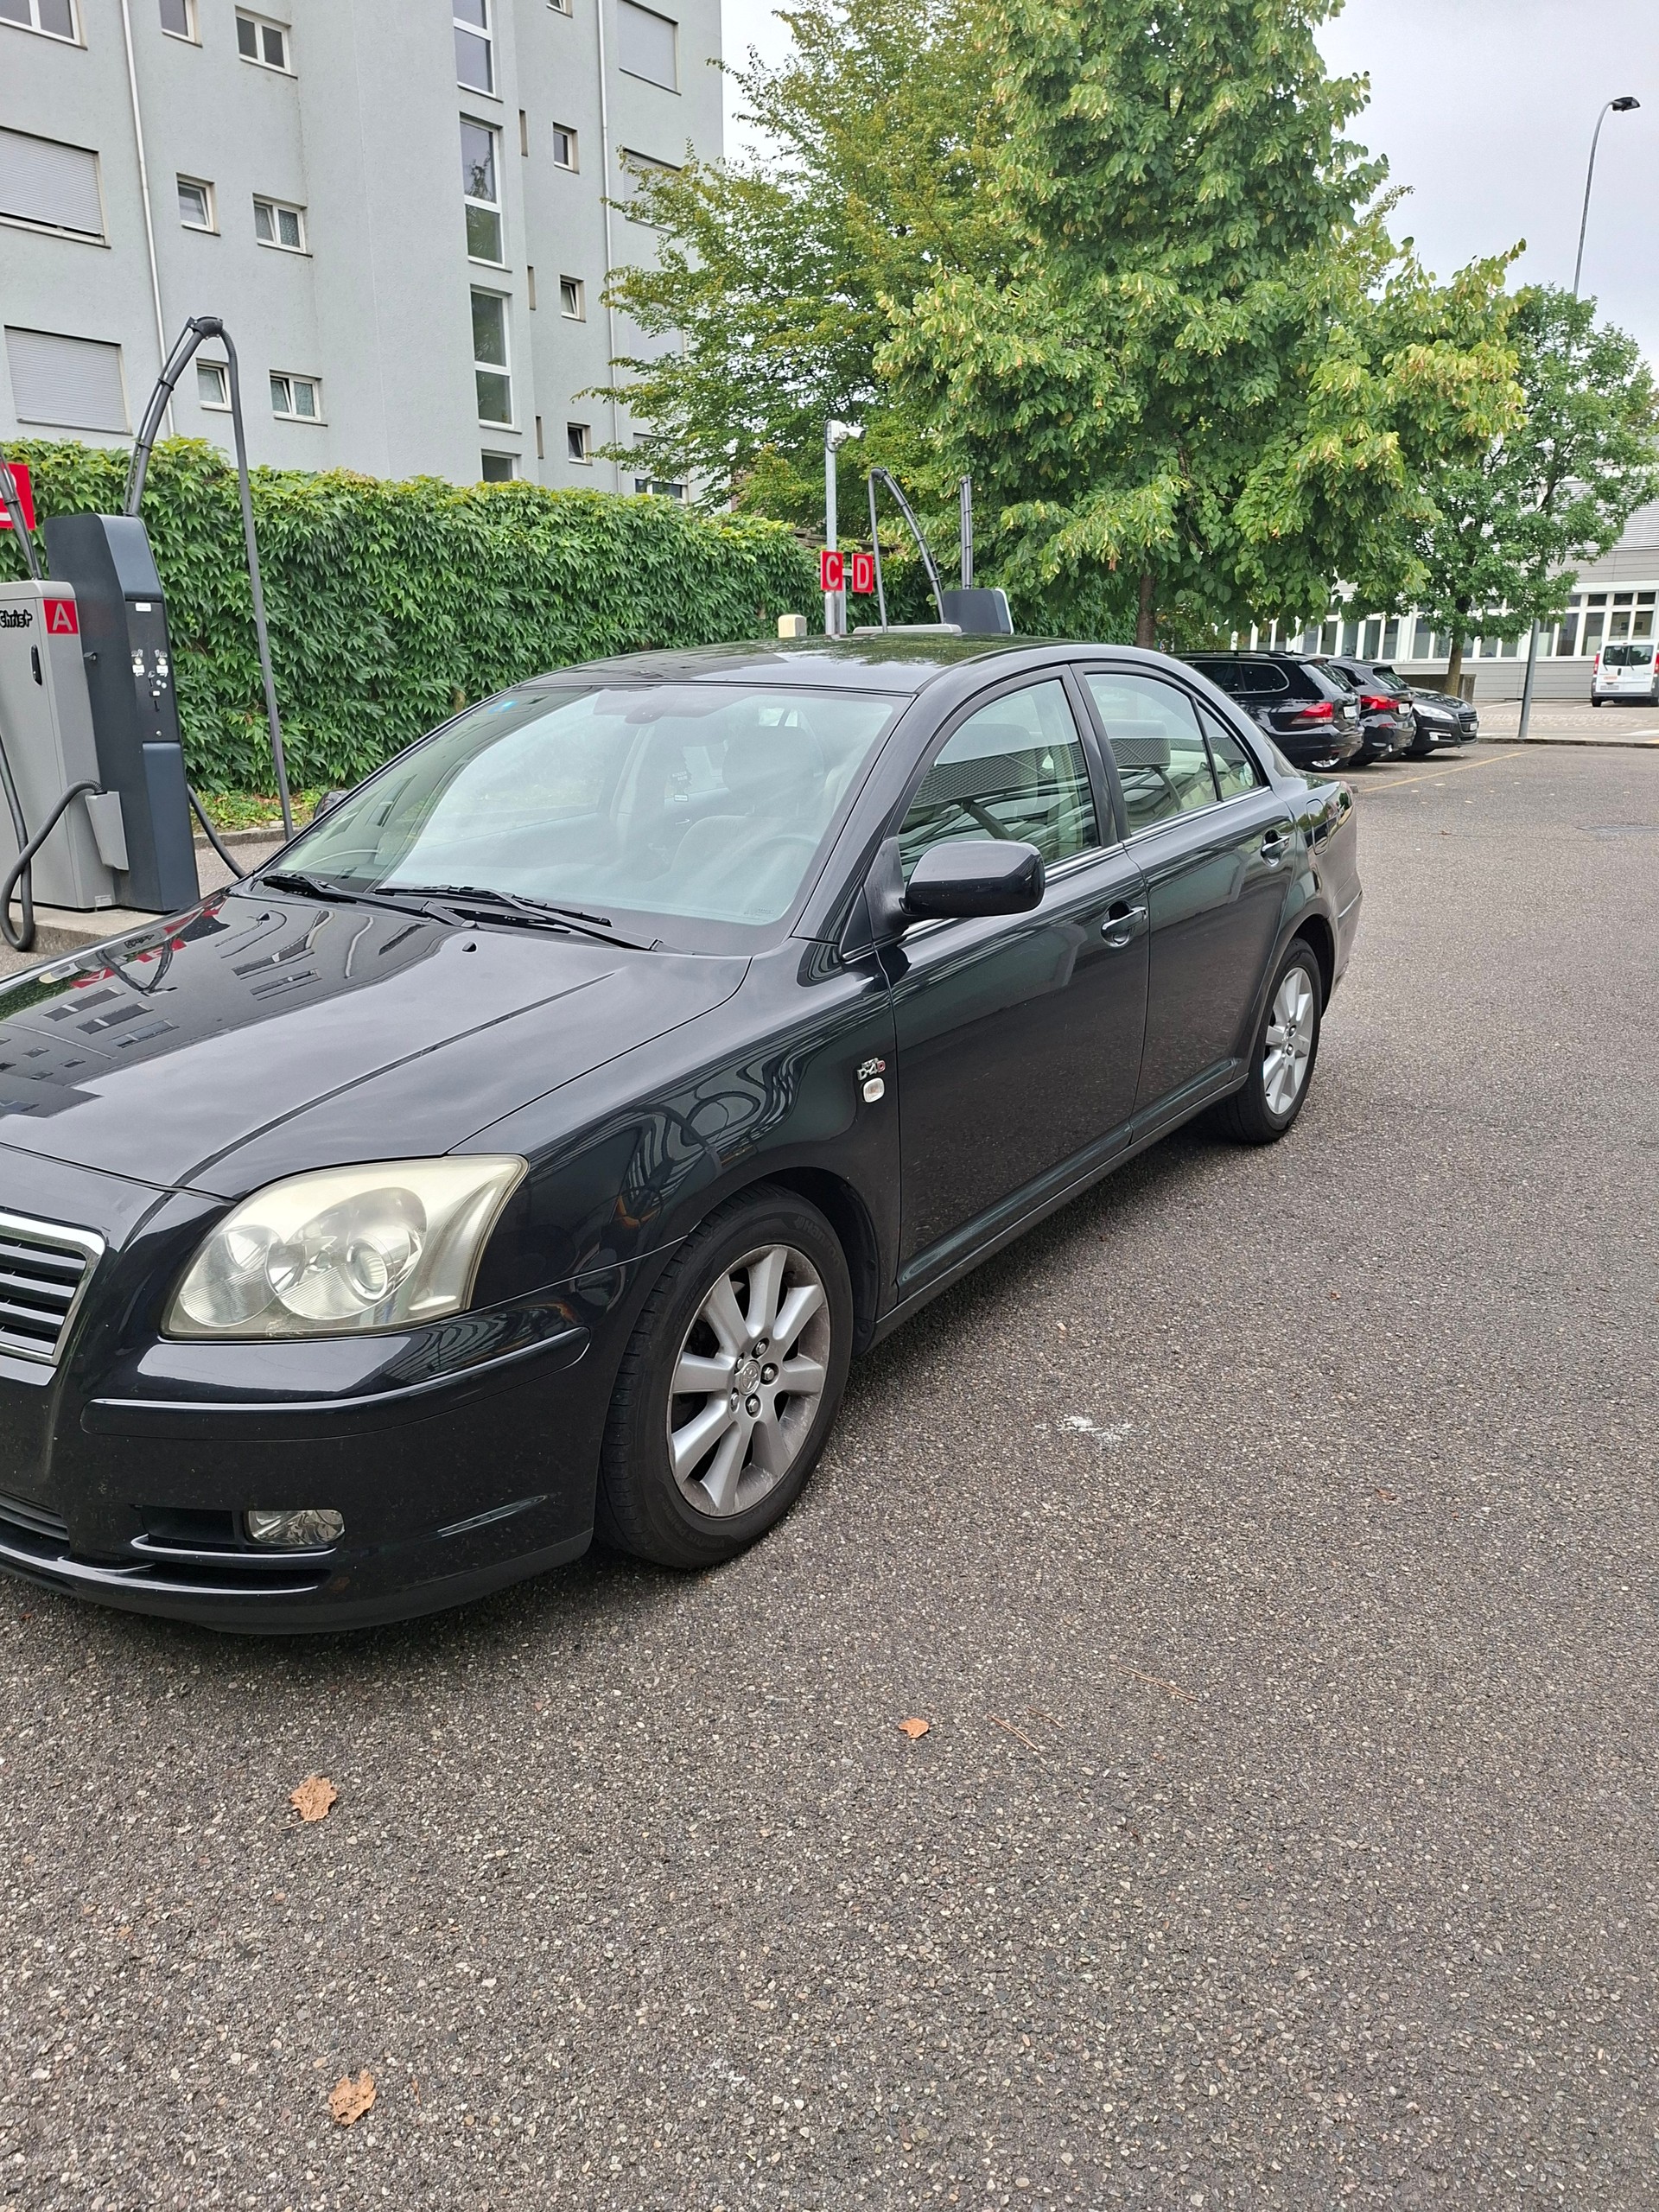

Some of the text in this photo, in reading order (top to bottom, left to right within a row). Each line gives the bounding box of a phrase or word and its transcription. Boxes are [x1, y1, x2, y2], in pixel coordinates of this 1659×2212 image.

[826, 555, 839, 587] C
[857, 558, 869, 588] D
[53, 603, 73, 631] A
